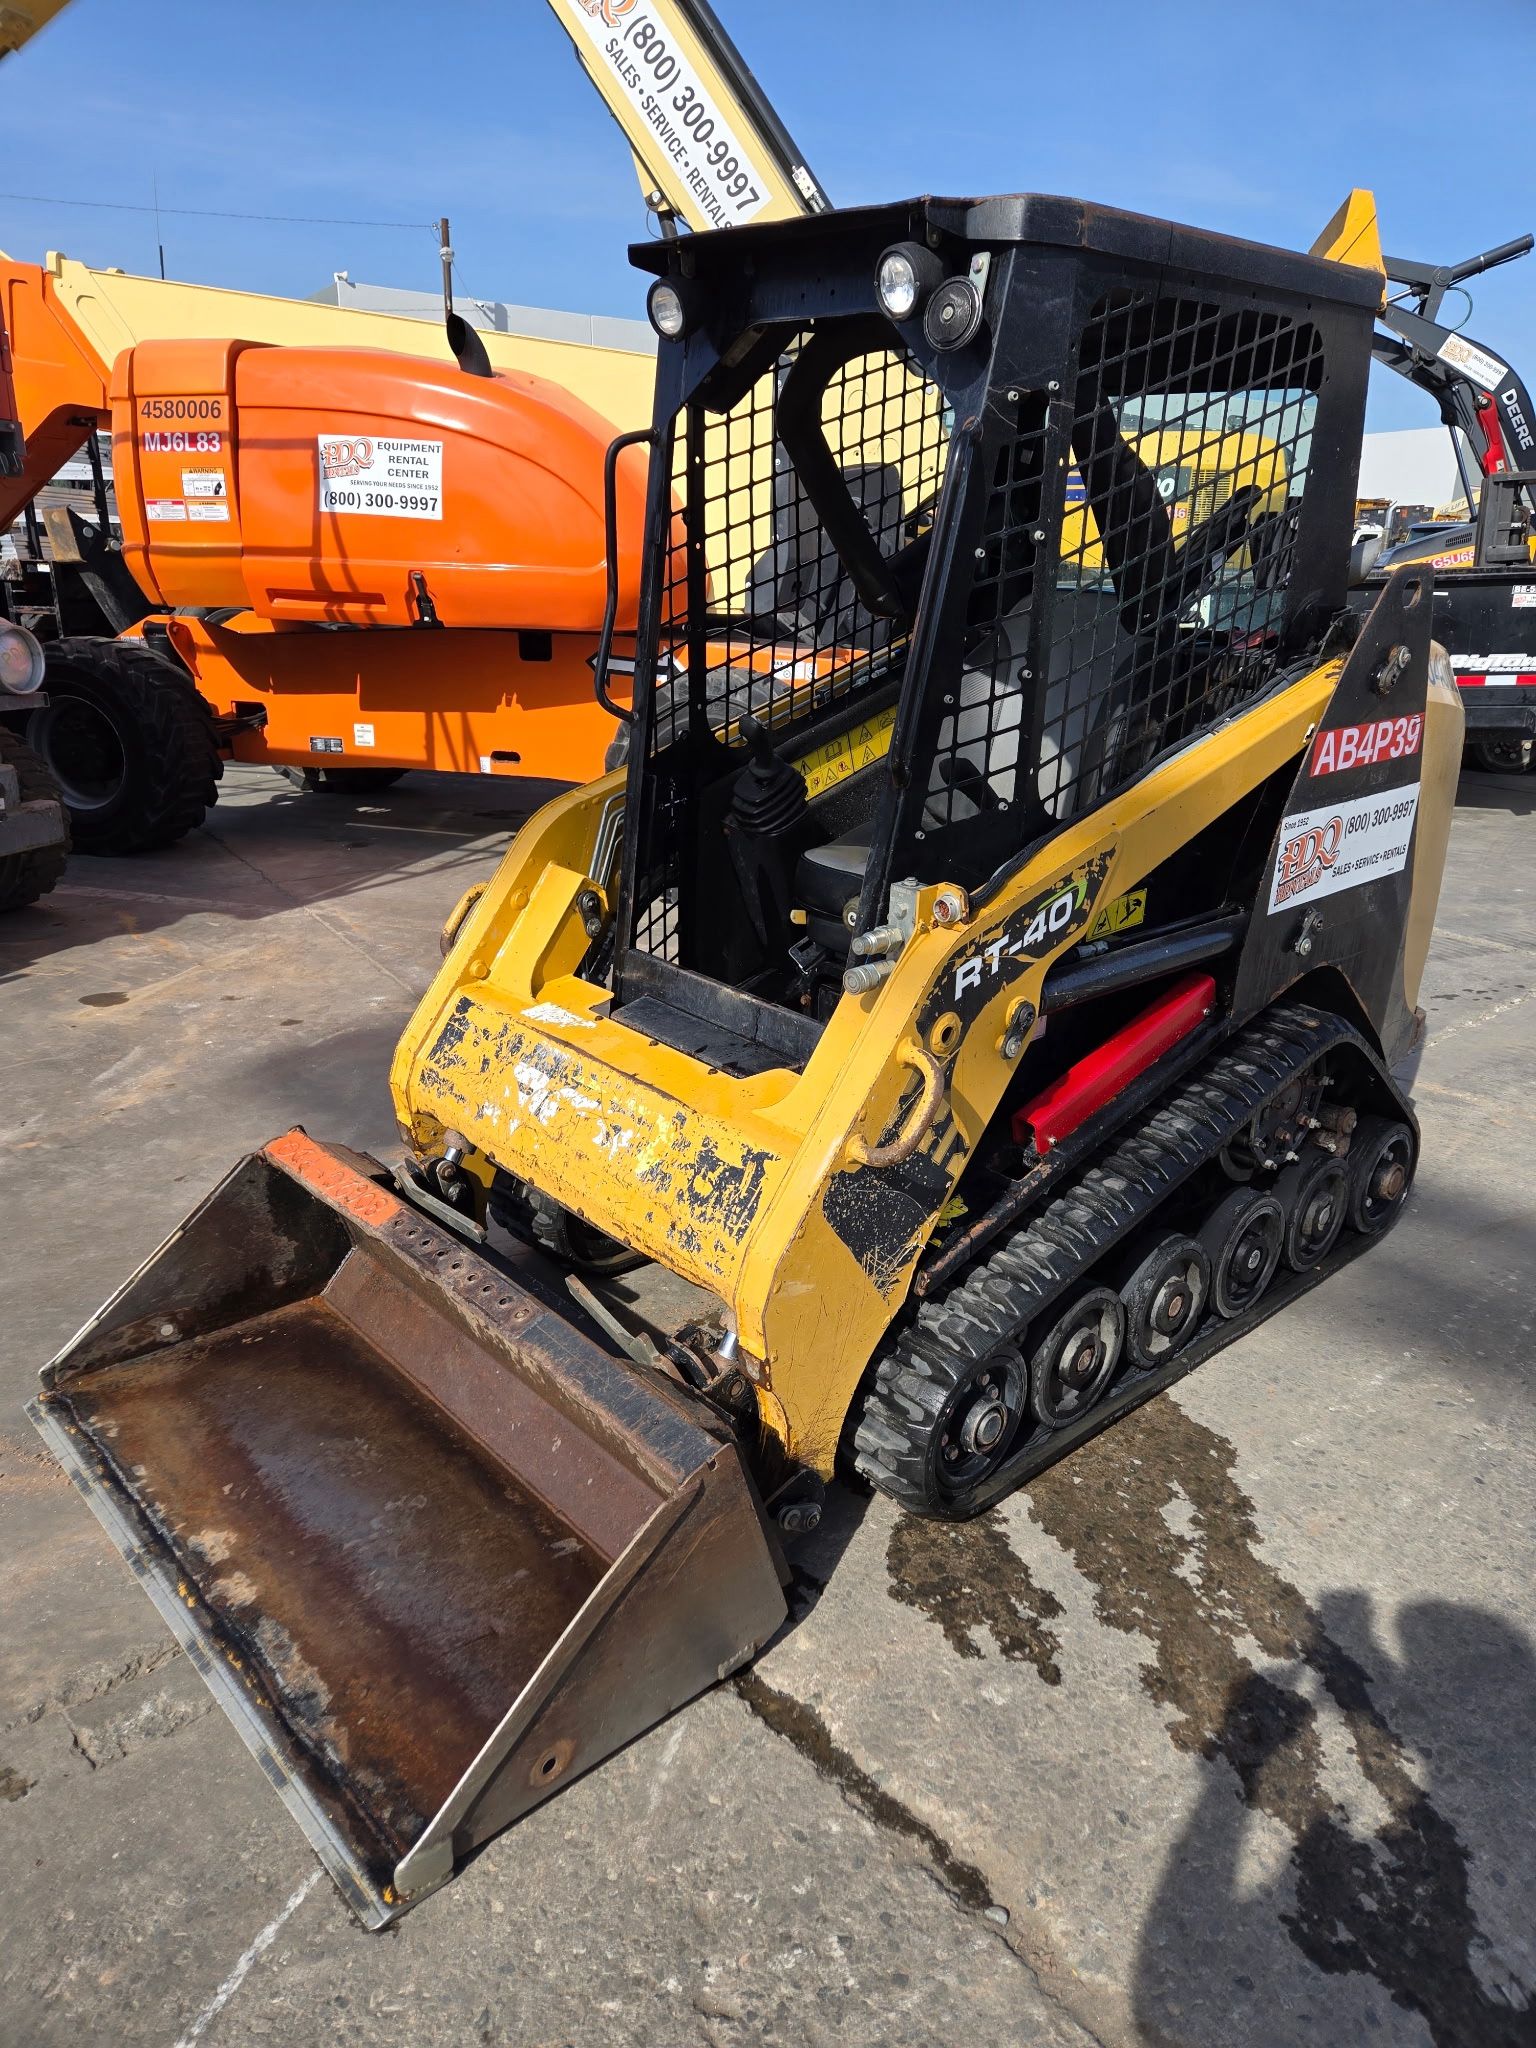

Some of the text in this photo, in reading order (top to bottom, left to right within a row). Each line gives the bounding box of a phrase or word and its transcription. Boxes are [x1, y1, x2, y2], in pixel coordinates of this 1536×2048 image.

[605, 37, 641, 89] SALES
[641, 95, 688, 163] SERVICE
[623, 15, 760, 211] (800) 300-9997
[141, 400, 221, 419] 4580006
[1501, 388, 1534, 450] DEERE
[144, 432, 221, 452] MJ6L83
[320, 438, 374, 469] PDQ
[377, 441, 442, 454] EQUIPMENT
[387, 468, 429, 479] CENTER
[388, 455, 429, 466] RENTAL
[350, 479, 373, 487] SERVING
[388, 481, 406, 489] NEEDS
[407, 482, 423, 490] SINCE
[324, 490, 438, 512] (800) 300-9997
[1313, 715, 1422, 776] AB4P39
[1284, 821, 1297, 831] Since
[1278, 799, 1415, 887] PDQ (800) 300-9997
[1332, 861, 1352, 878] SALES
[1354, 853, 1380, 870] SERVICE
[1382, 843, 1407, 861] RENTALS
[955, 892, 1073, 1001] RT-40
